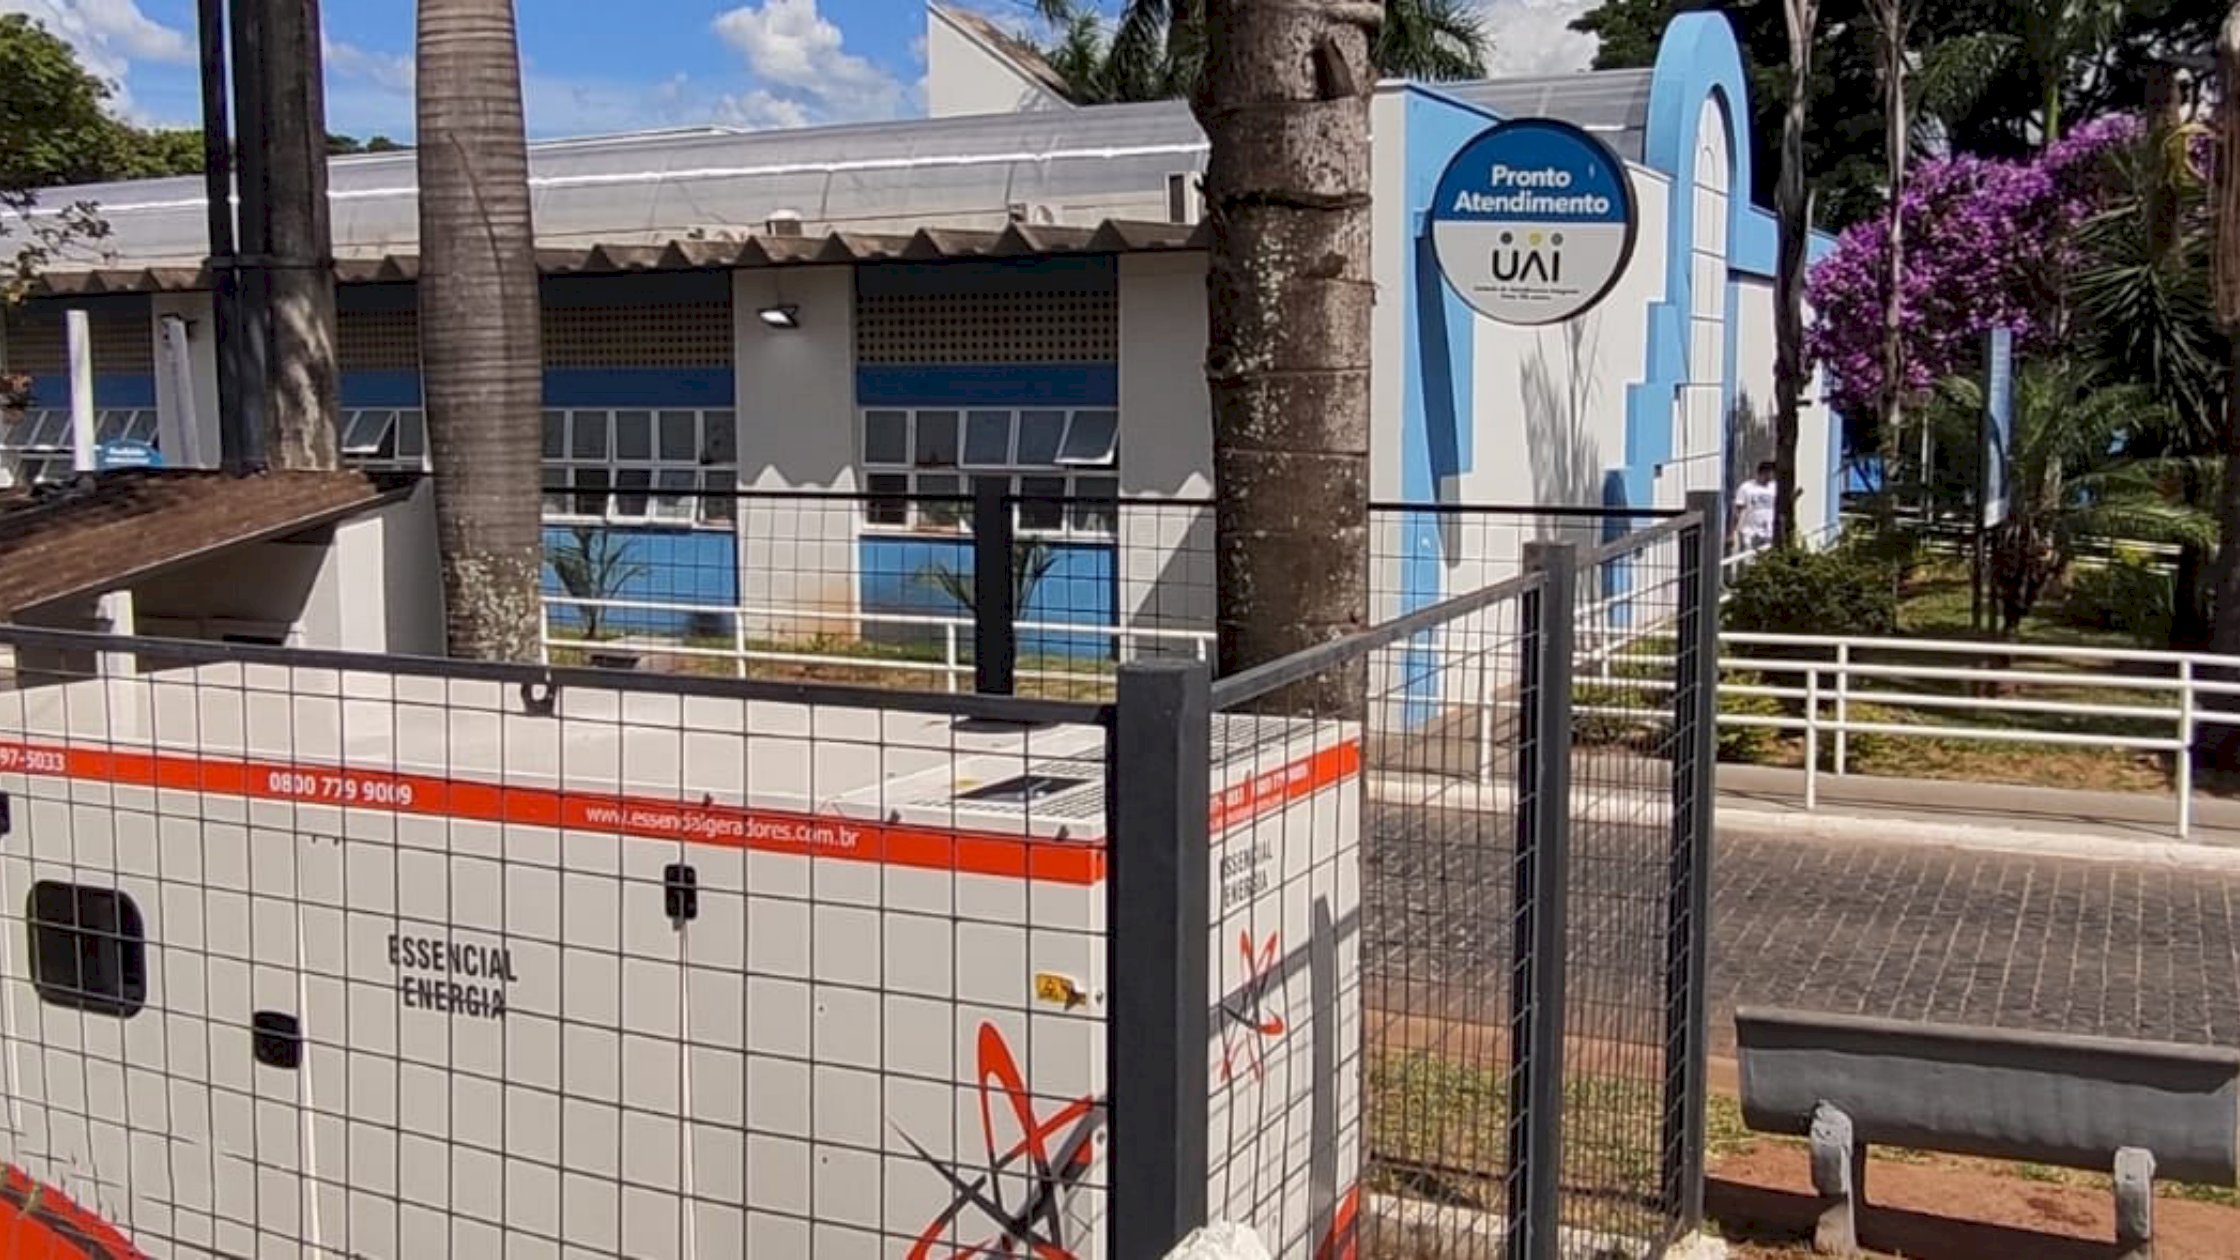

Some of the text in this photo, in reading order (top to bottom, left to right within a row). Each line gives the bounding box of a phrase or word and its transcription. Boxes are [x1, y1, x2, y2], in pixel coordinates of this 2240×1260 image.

[1491, 164, 1571, 188] Pronto
[1453, 190, 1611, 214] Atendimento
[1492, 246, 1560, 282] UAI
[269, 772, 412, 805] 0800 779 9009
[388, 935, 517, 983] ESSENCIAL
[403, 977, 505, 1021] ENERGIA
